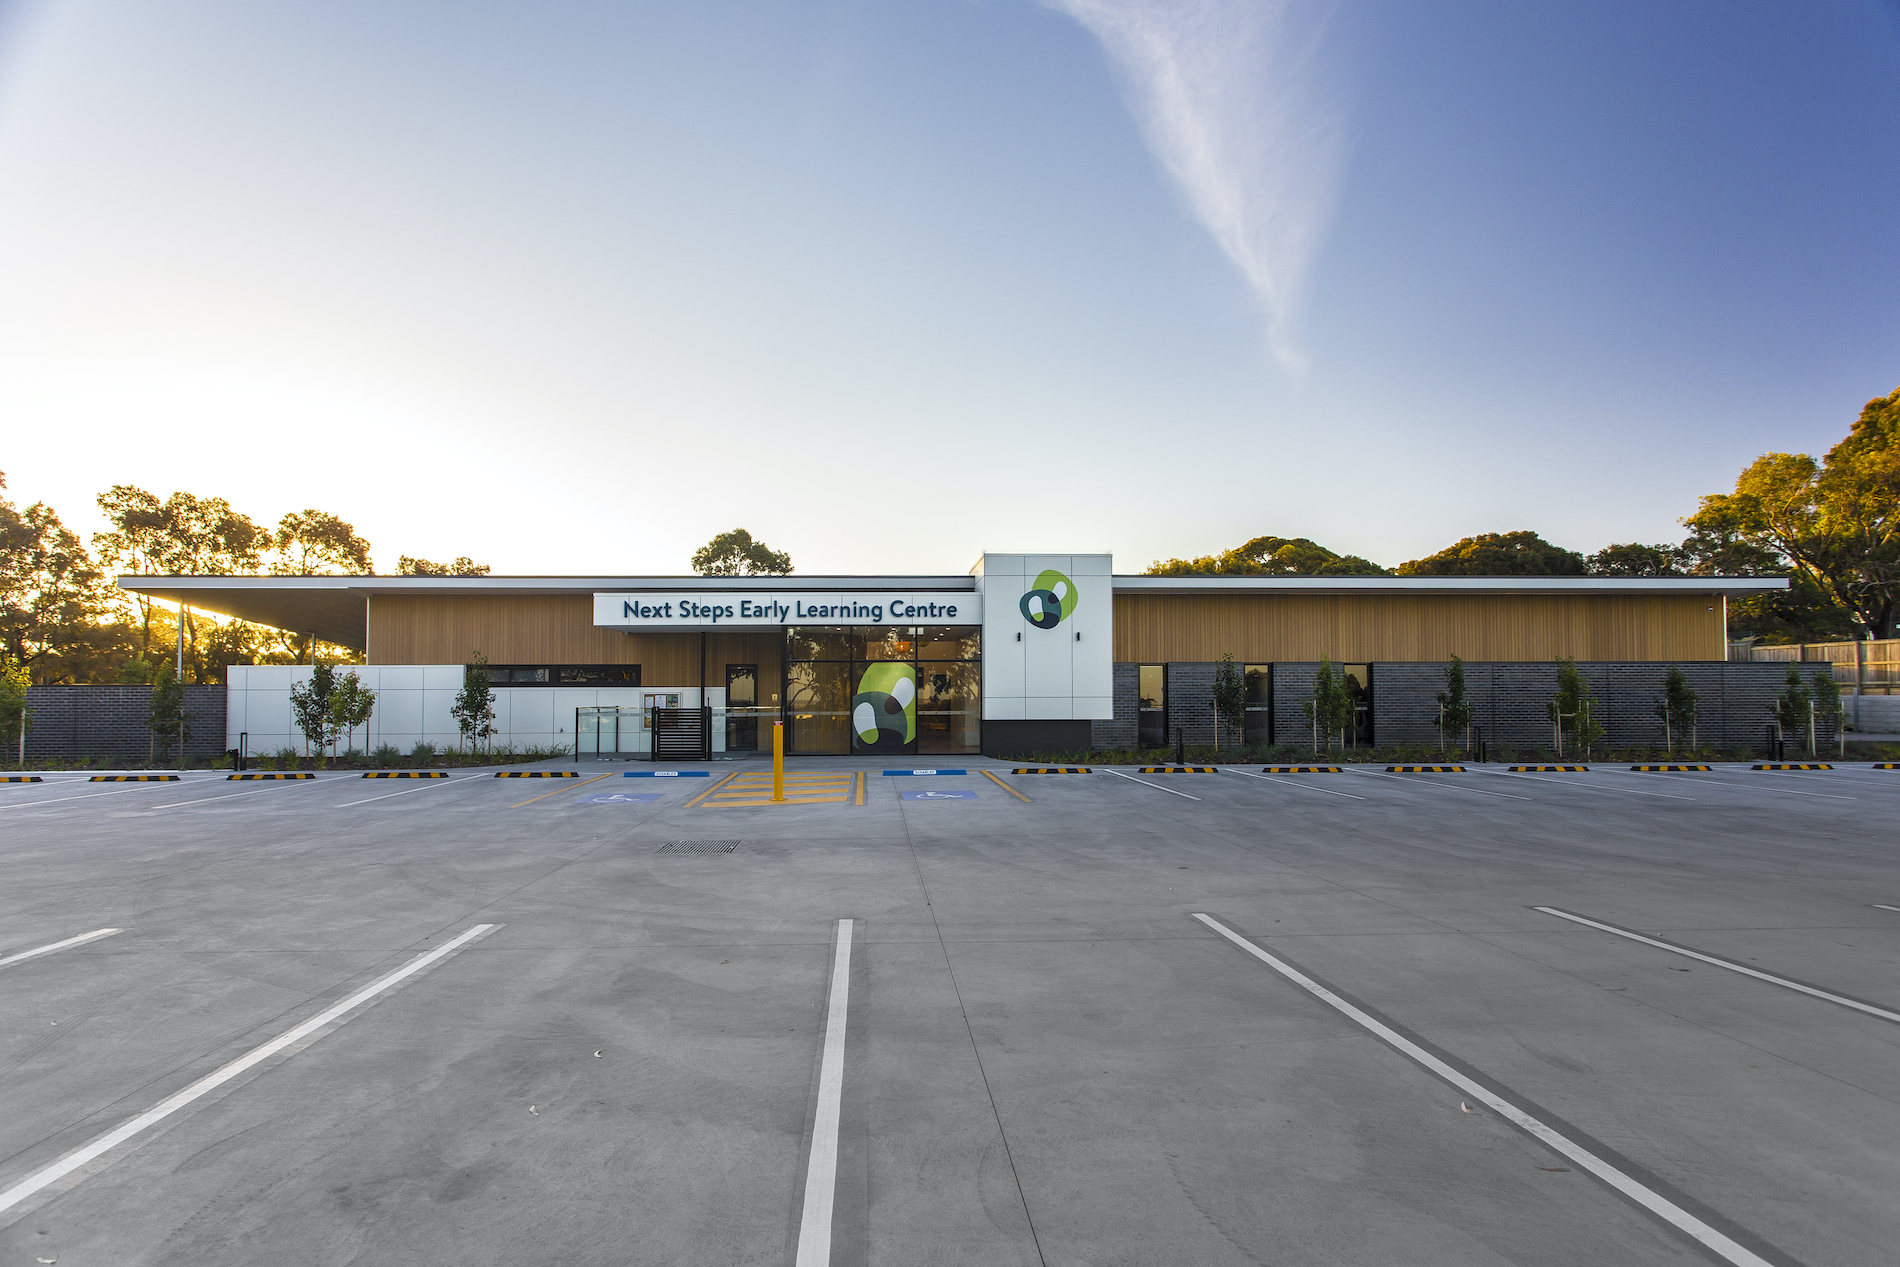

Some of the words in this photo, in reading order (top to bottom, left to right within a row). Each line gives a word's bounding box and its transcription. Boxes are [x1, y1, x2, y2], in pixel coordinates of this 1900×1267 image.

[624, 600, 672, 618] Next
[679, 600, 734, 623] Steps
[740, 600, 790, 623] Early
[796, 600, 883, 622] Learning
[889, 600, 958, 617] Centre
